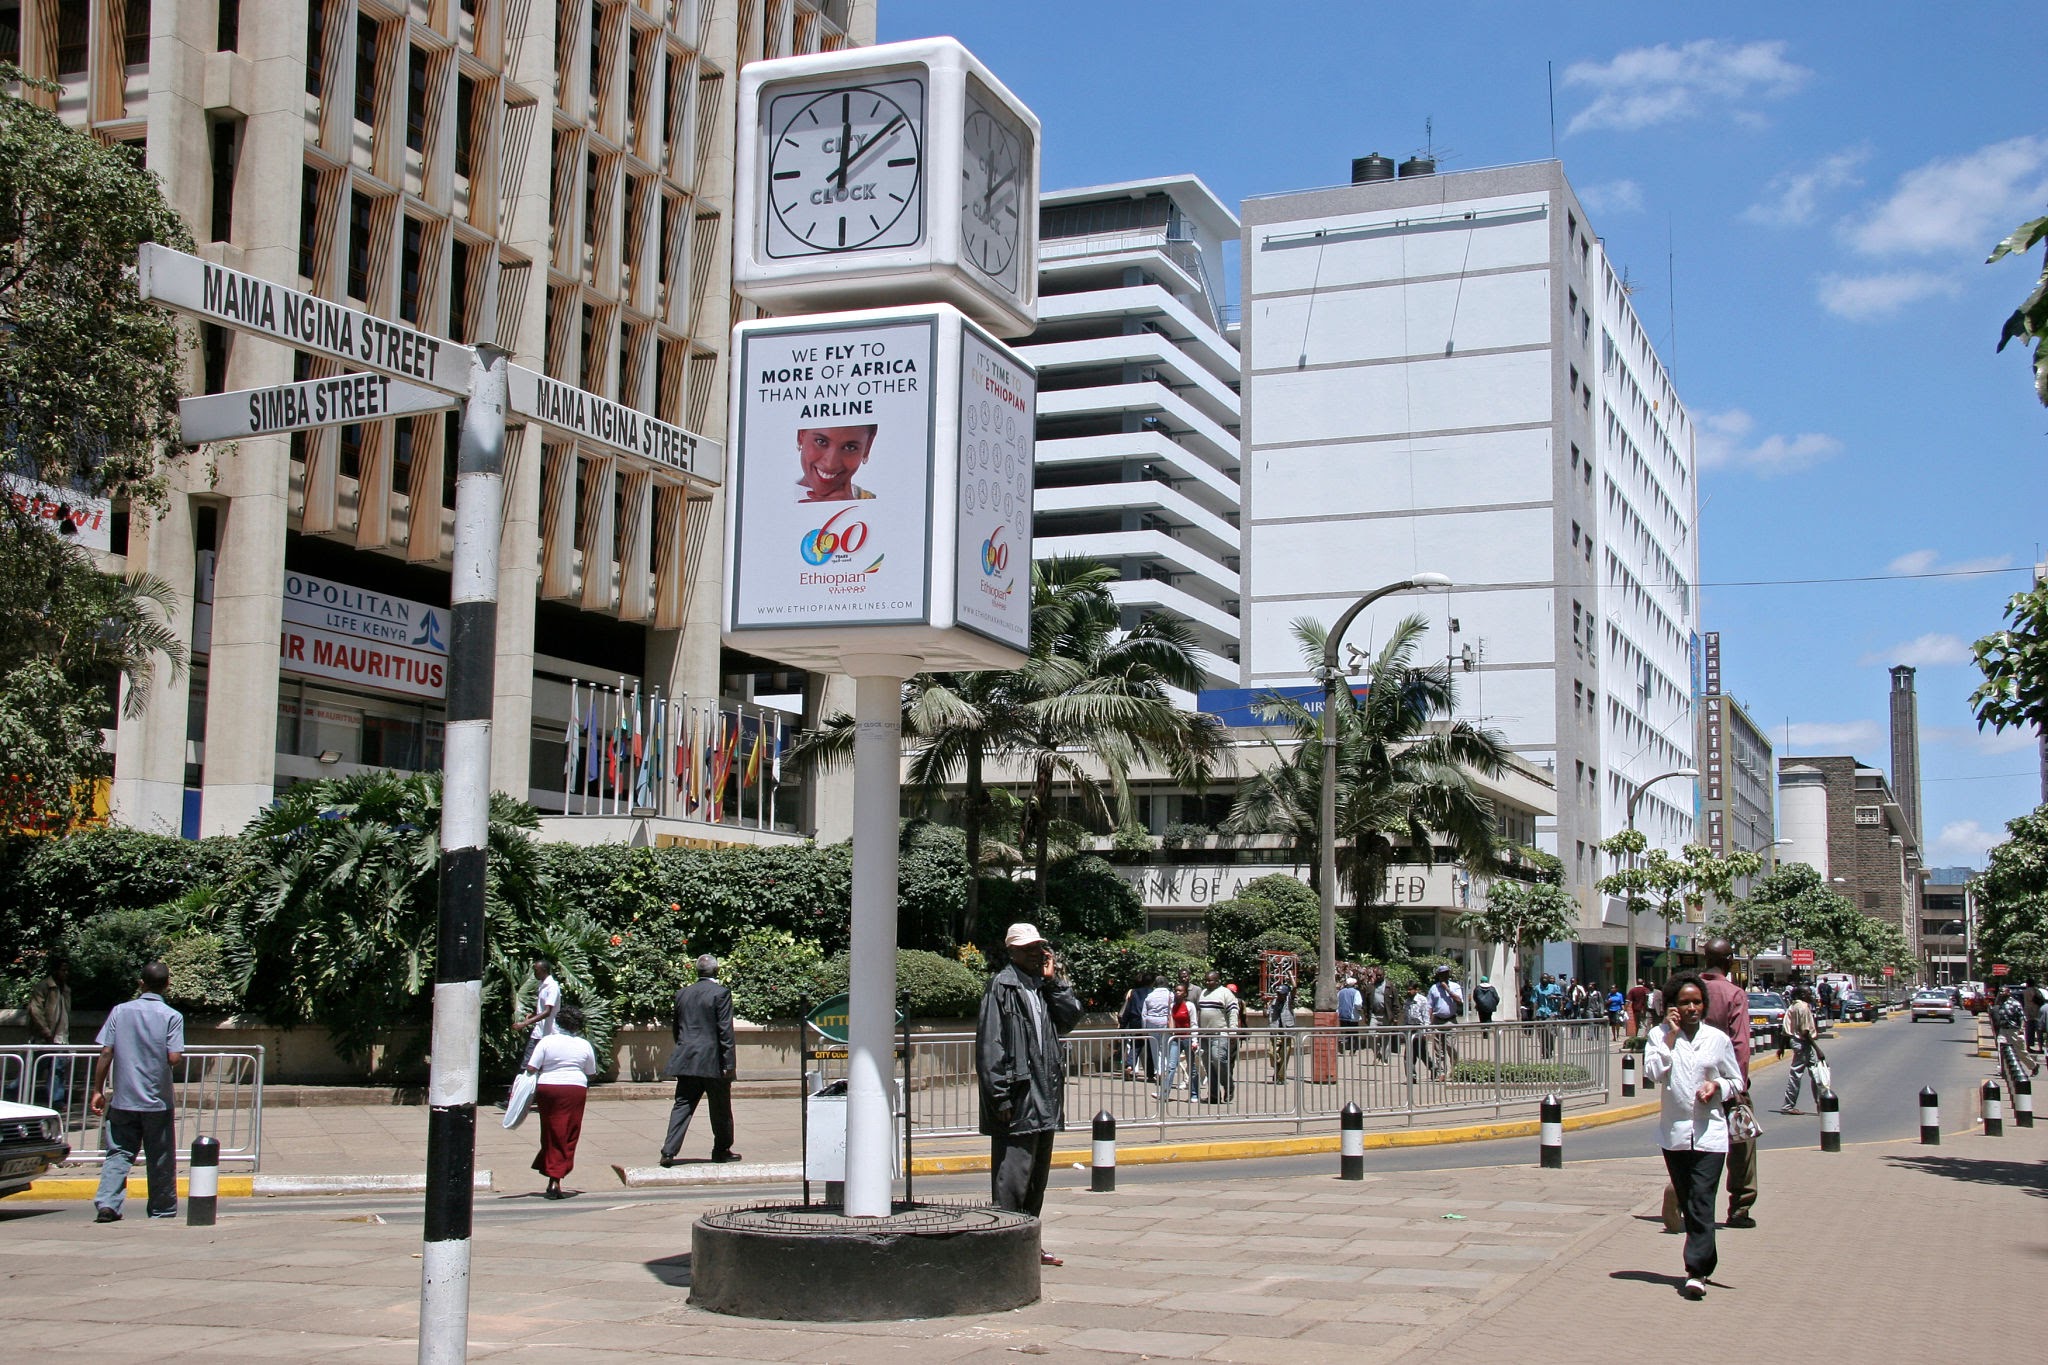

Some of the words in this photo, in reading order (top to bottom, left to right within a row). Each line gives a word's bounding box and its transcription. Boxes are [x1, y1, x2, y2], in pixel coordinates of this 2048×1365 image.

[979, 156, 998, 182] CIY
[809, 183, 878, 205] CLOCK
[203, 264, 276, 331] MAMA
[284, 291, 354, 356] NGINA
[361, 318, 440, 382] STREET
[762, 367, 814, 384] MORE
[821, 365, 844, 379] OF
[850, 359, 917, 377] AFRICA
[792, 348, 818, 363] WE
[825, 345, 855, 361] FLY
[860, 342, 885, 357] TO
[977, 352, 990, 372] IT'S
[992, 361, 1009, 385] TIME
[1012, 374, 1022, 392] TO
[250, 386, 310, 432] SIMBA
[316, 375, 391, 422] STREET
[758, 386, 807, 403] THAN
[814, 383, 850, 399] ANY
[857, 378, 918, 395] OTHER
[800, 400, 874, 419] AIRLINE
[971, 368, 984, 385] FLY
[985, 377, 1025, 413] ETHIOPIAN
[537, 378, 585, 431] MAMA
[591, 398, 638, 450] NGINA
[643, 419, 697, 473] STREET
[11, 492, 103, 531] alawi
[816, 505, 868, 554] 60
[988, 525, 1008, 570] 60
[800, 571, 866, 586] Ethiopian
[981, 579, 1007, 600] Ethiopian
[287, 577, 409, 620] OPOLITAN
[757, 601, 913, 614] WWW.ETHIOPIANAIRLINES.COM
[327, 613, 357, 630] LIFE
[363, 621, 406, 641] KENYA
[281, 633, 305, 661] IR
[313, 640, 442, 688] MAURITIUS
[1706, 633, 1718, 693] Trans
[1708, 701, 1722, 798] National
[1711, 813, 1721, 858] Plaz
[1123, 877, 1180, 894] ANK
[1191, 877, 1220, 894] OF
[816, 1015, 850, 1027] LITT
